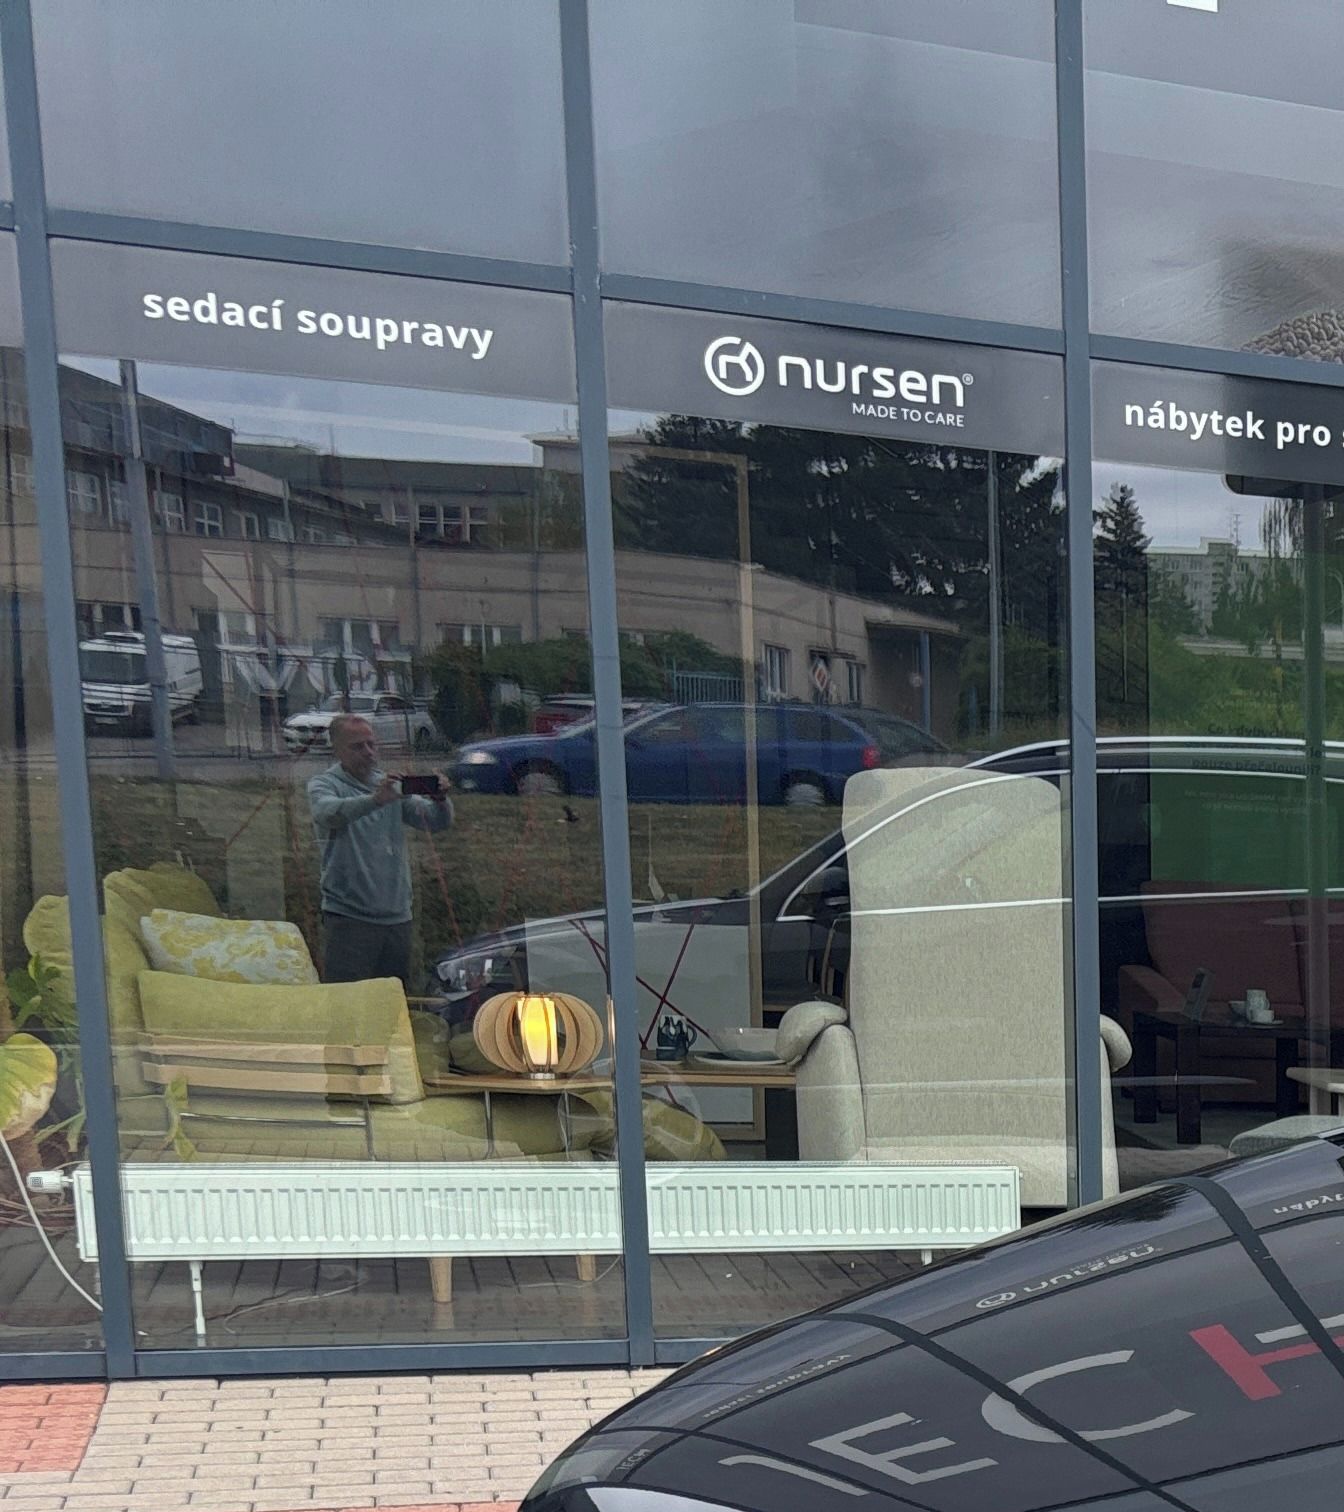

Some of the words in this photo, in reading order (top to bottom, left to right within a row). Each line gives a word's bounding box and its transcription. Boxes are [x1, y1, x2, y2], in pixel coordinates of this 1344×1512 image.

[144, 293, 283, 330] sedací
[298, 311, 492, 359] soupravy
[779, 355, 965, 407] nursen
[853, 403, 897, 420] MADE
[900, 408, 922, 423] TO
[925, 412, 964, 427] CARE
[1125, 400, 1265, 440] nábytek
[1277, 422, 1331, 449] pro
